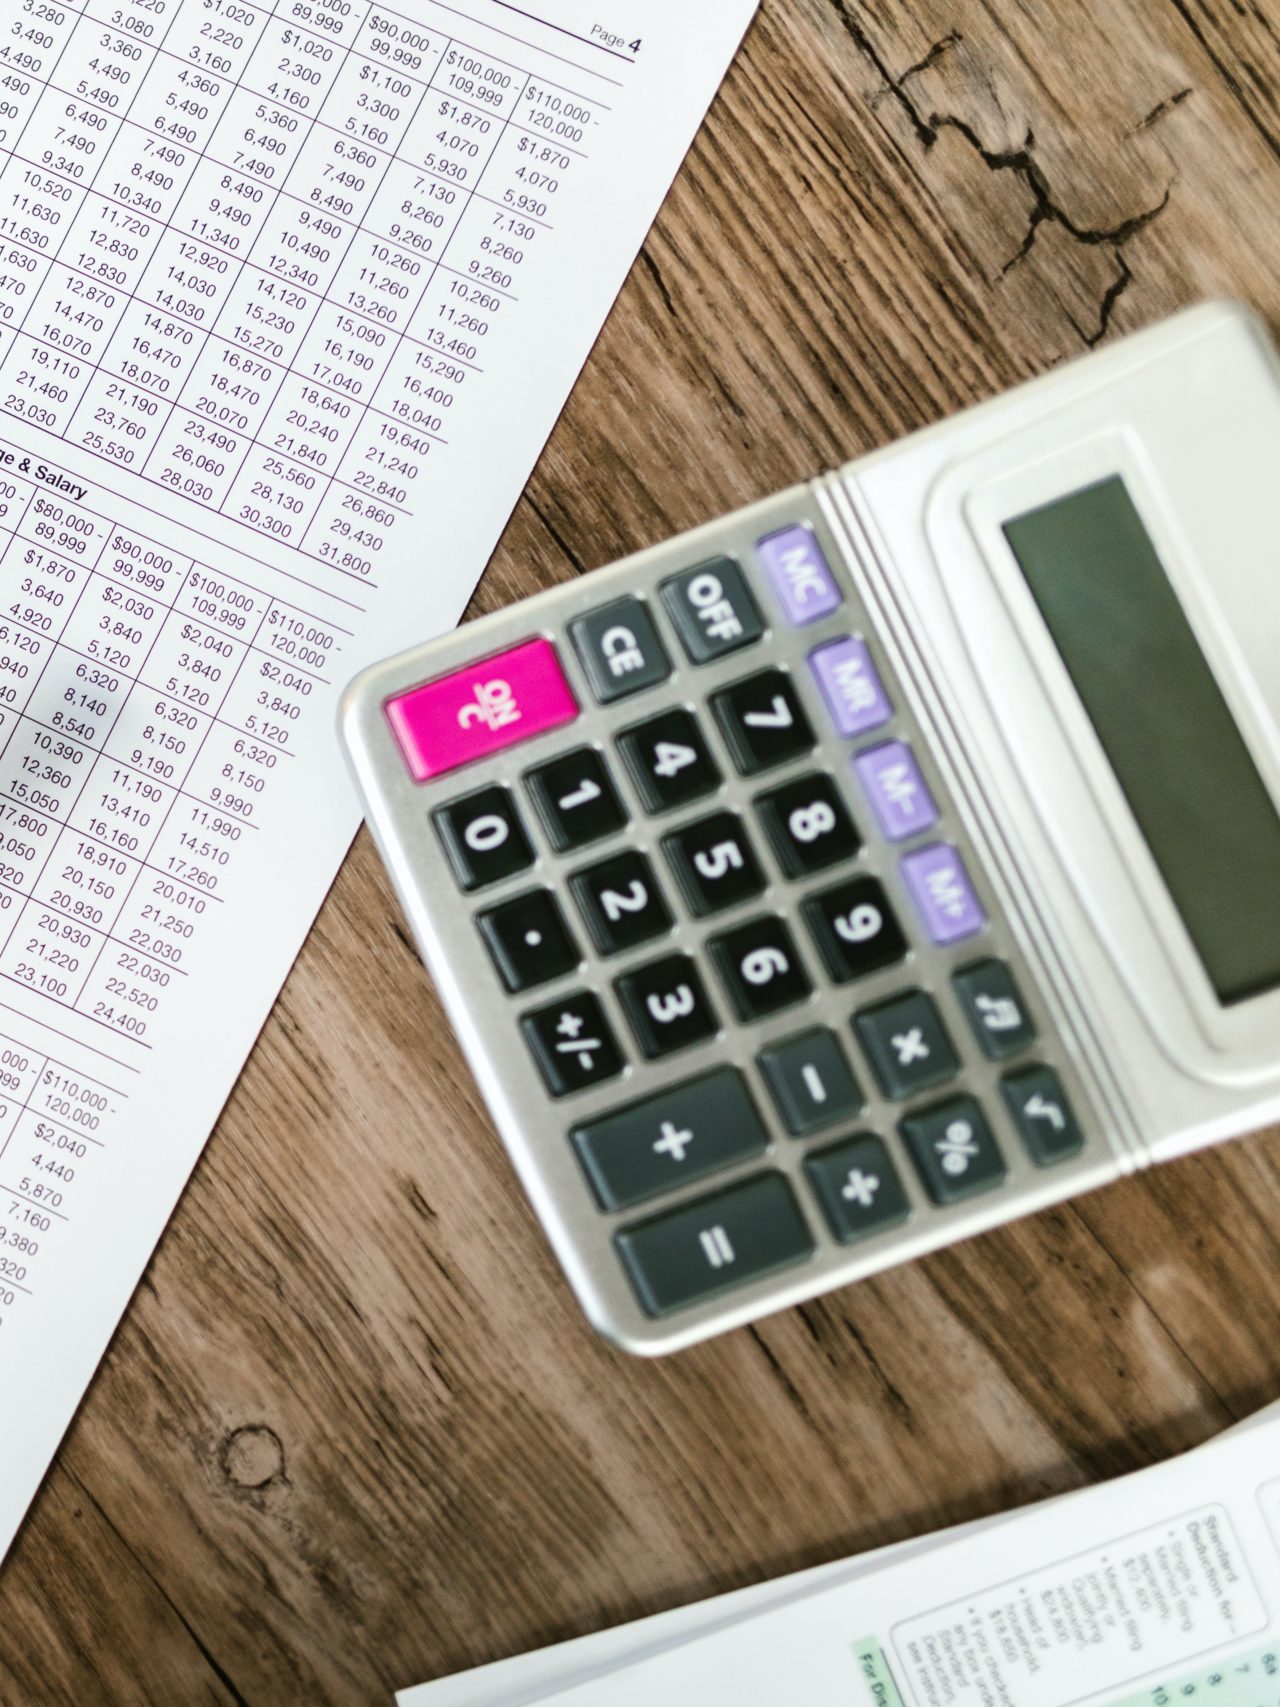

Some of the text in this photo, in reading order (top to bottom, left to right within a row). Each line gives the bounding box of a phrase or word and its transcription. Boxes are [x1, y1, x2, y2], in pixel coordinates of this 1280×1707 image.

[590, 23, 642, 53] Page 4
[281, 29, 570, 169] $1,020 $1,100 $1,870 $1,870
[369, 37, 582, 142] 99,999 109,999 120,000
[356, 93, 399, 121] 3,300
[413, 175, 455, 204] 7,130
[450, 280, 500, 311] 10,260
[427, 327, 476, 359] 13,460
[403, 375, 453, 407] 16,400
[380, 423, 429, 455] 19,640
[17, 457, 30, 474] &
[34, 464, 88, 500] Salary
[352, 470, 406, 503] 22,840
[81, 431, 134, 463] 25,530
[160, 467, 213, 500] 28,030
[239, 505, 291, 537] 30,300
[318, 542, 371, 575] 31,800
[341, 494, 394, 527] 26,860
[329, 518, 383, 551] 29,430
[781, 545, 827, 600] MC
[687, 573, 744, 641] OFF
[271, 633, 325, 667] 120,000
[601, 626, 645, 677] CE
[75, 663, 118, 692] 6,320
[833, 657, 877, 712] MR
[63, 687, 107, 716] 8,140
[745, 697, 792, 726] 7
[51, 711, 95, 740] 8,540
[33, 731, 83, 764] 10,390
[655, 743, 696, 775] 4
[22, 755, 71, 788] 12,360
[10, 779, 59, 812] 15,050
[560, 780, 600, 809] 1
[466, 816, 508, 850] 0
[790, 802, 835, 841] 8
[695, 842, 742, 877] 5
[152, 880, 205, 913] 20,010
[601, 881, 647, 919] 2
[835, 905, 881, 941] 9
[742, 948, 787, 983] 6
[92, 1001, 146, 1035] 24,400
[648, 986, 693, 1022] 3
[1202, 1515, 1238, 1582] Standard
